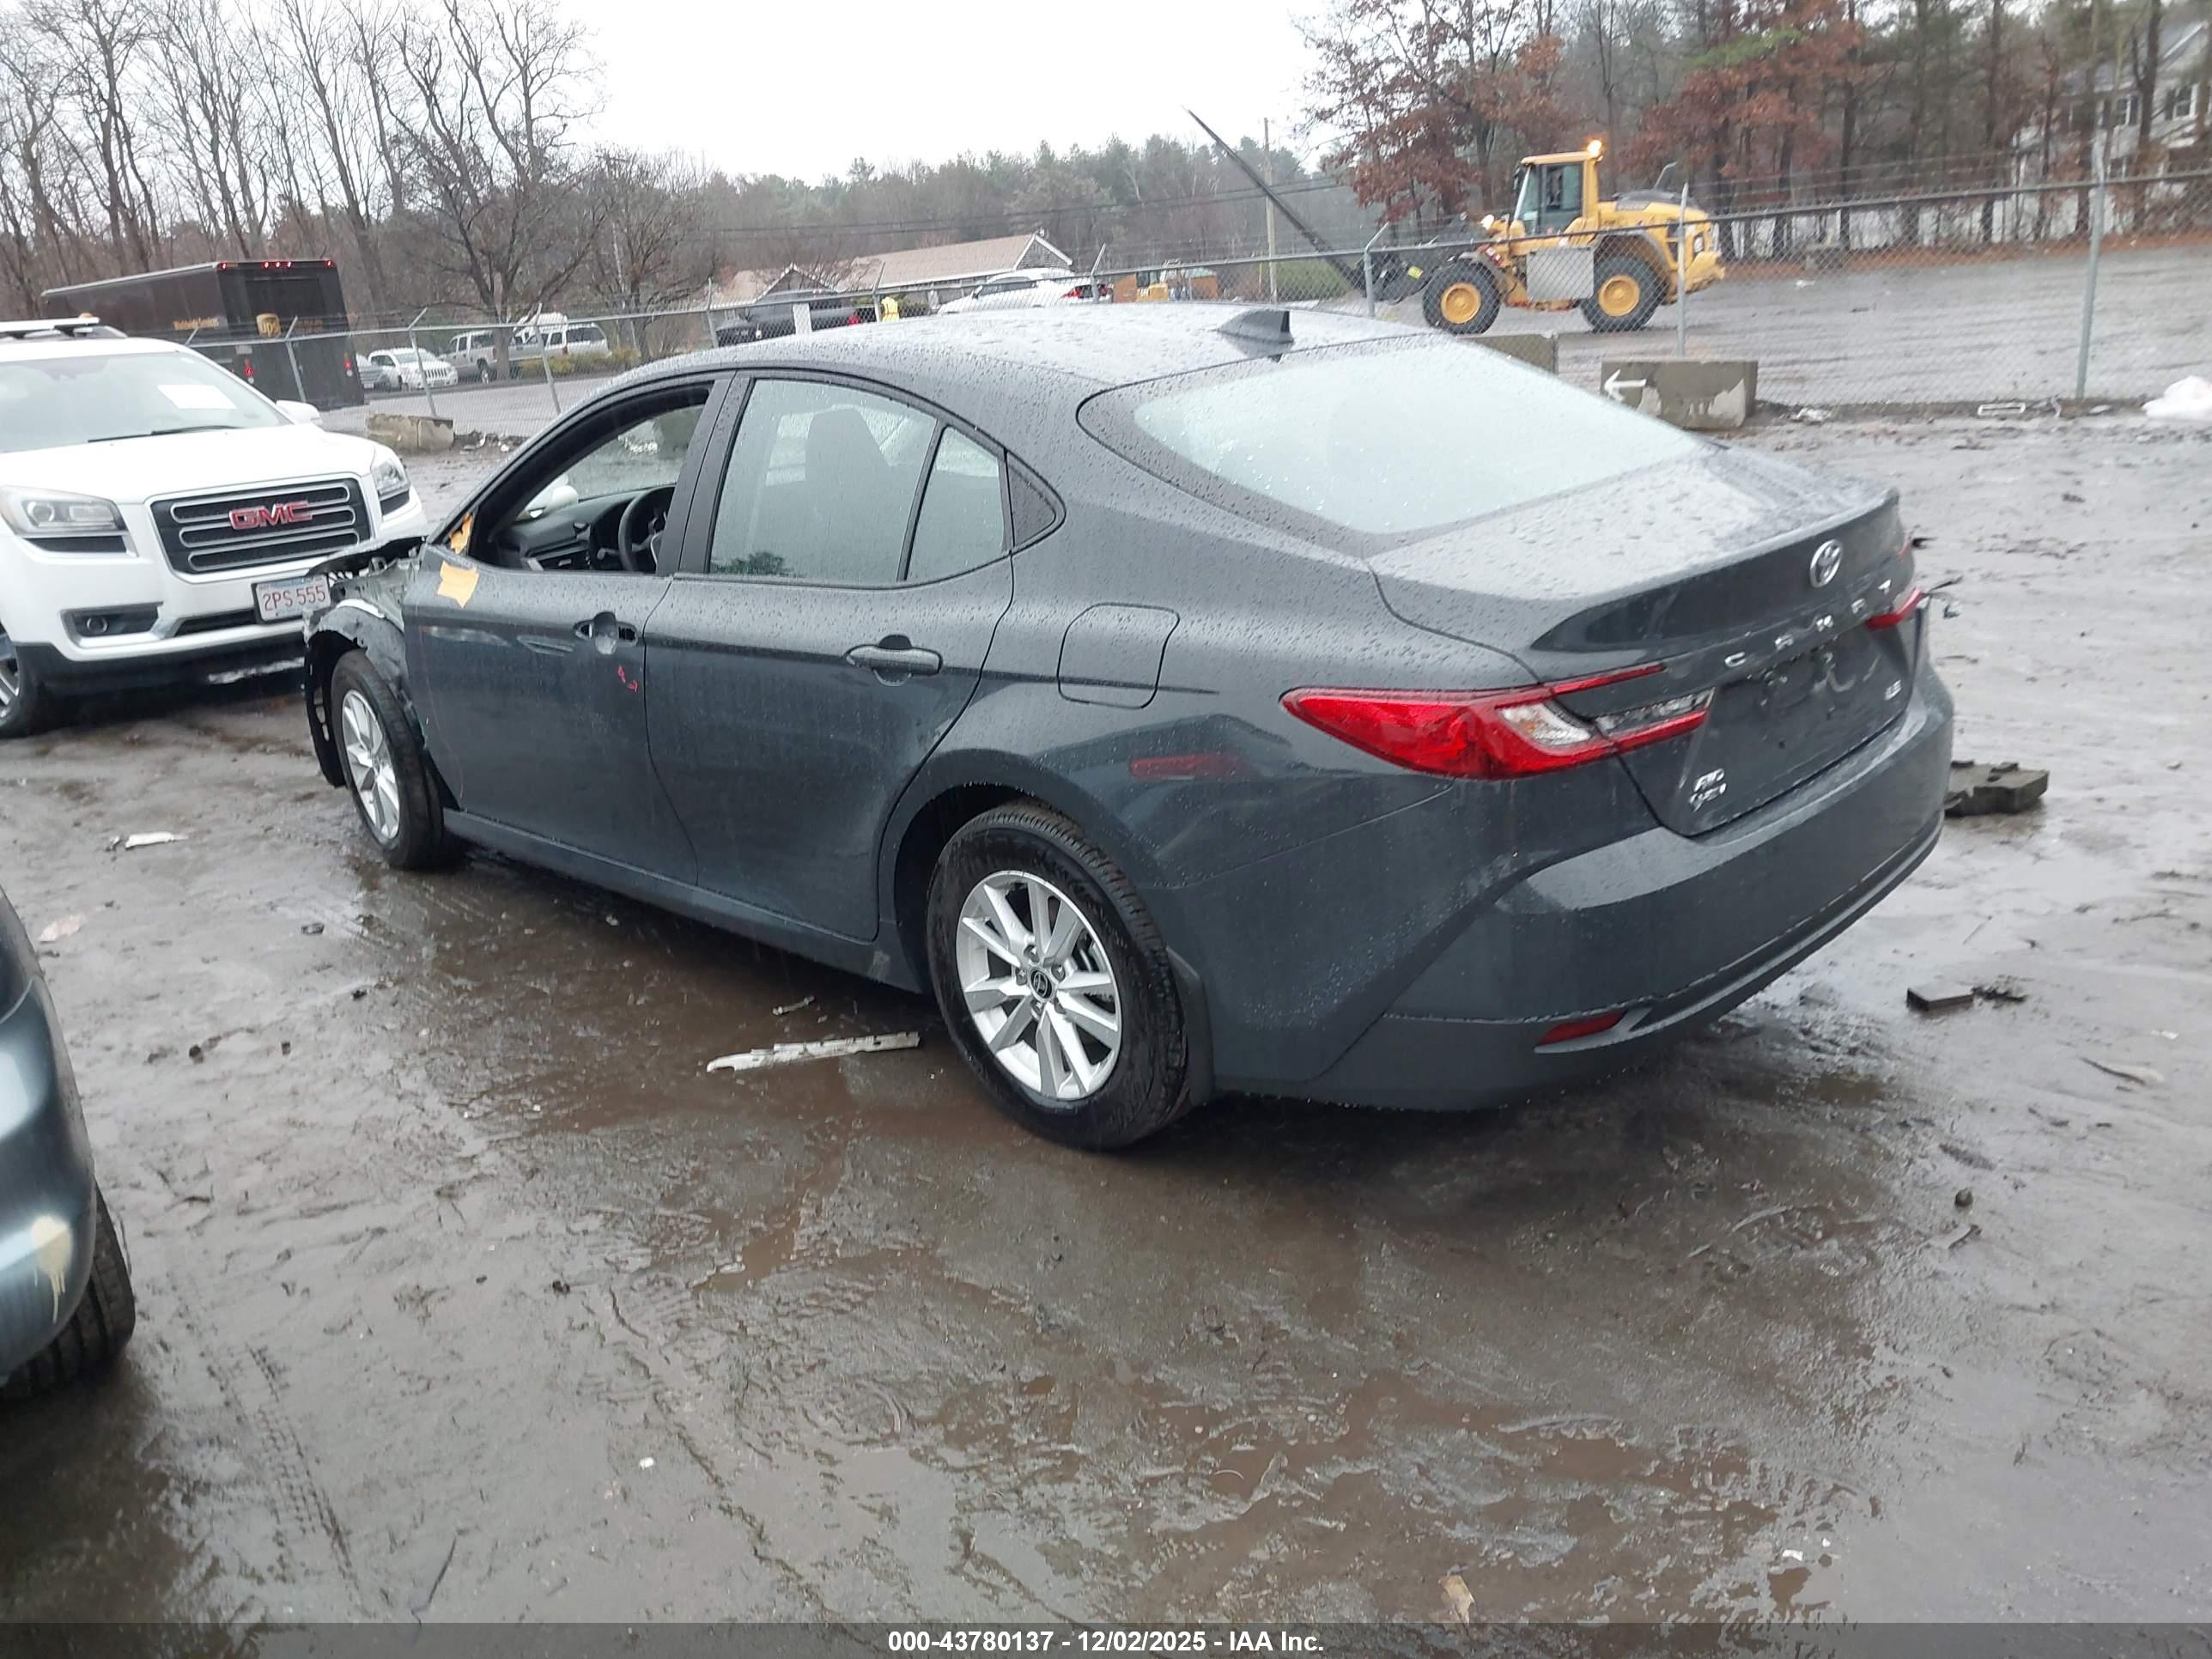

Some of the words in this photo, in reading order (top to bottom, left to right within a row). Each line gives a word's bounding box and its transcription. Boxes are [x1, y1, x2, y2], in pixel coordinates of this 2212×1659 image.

[229, 500, 313, 530] GMC
[262, 590, 294, 611] 2PS
[295, 584, 326, 606] 555
